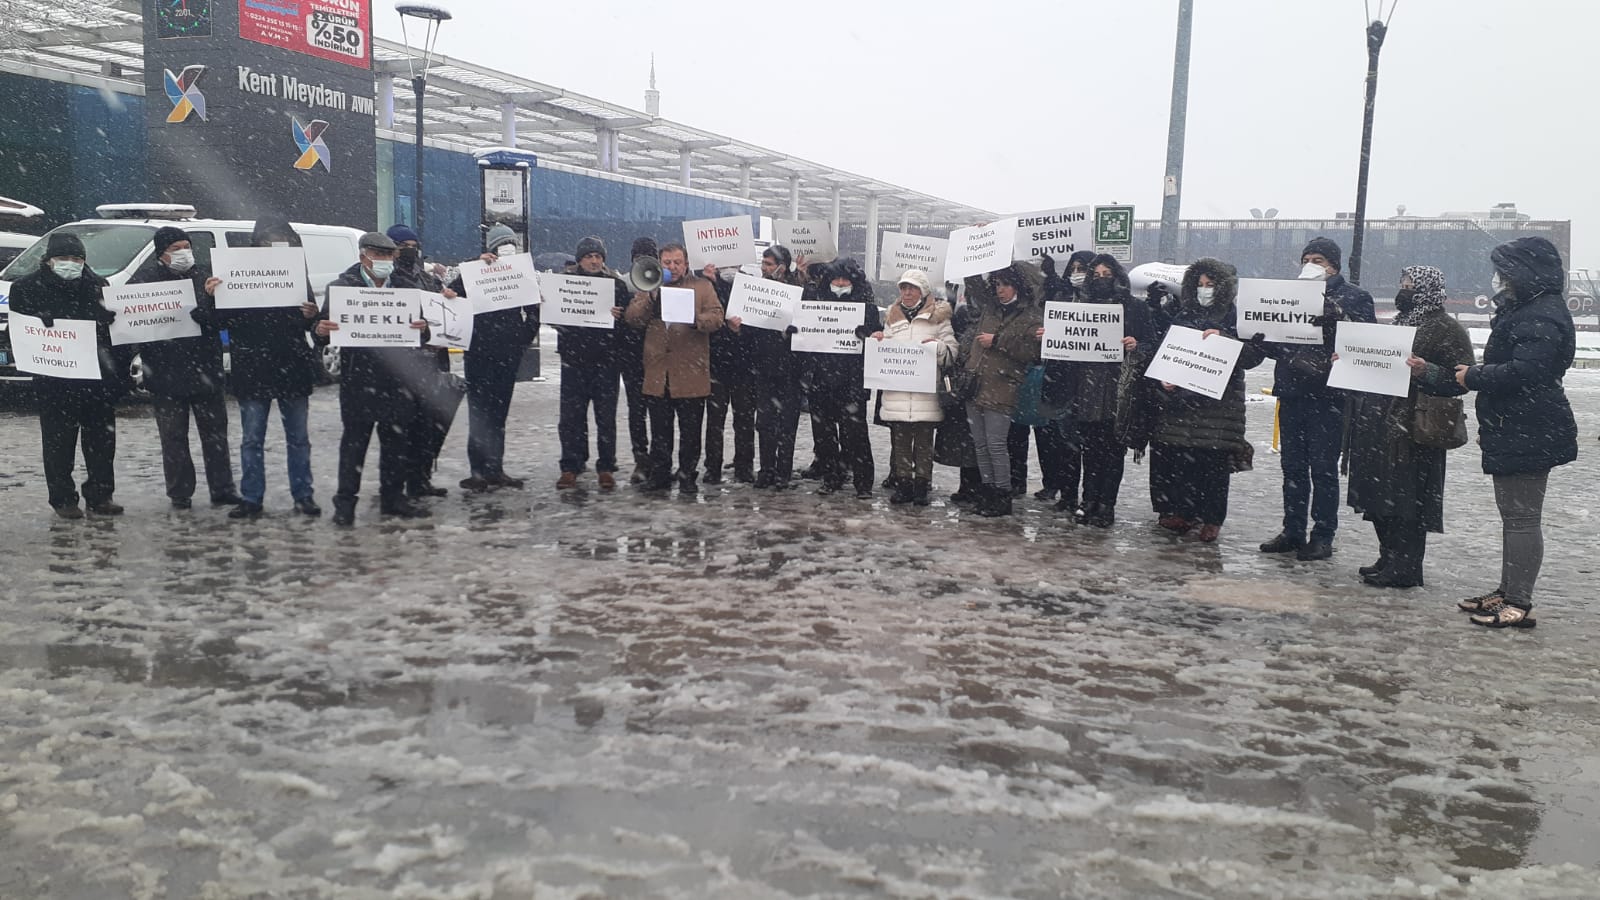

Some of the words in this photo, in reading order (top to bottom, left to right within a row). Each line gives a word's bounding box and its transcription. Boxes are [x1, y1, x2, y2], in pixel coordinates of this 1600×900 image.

[328, 14, 355, 26] ÜRÜN
[311, 19, 360, 47] %50
[314, 36, 358, 56] İNDİRİMLİ
[237, 65, 277, 96] Kent
[282, 75, 346, 110] Meydanı
[351, 95, 374, 116] AVM
[1018, 212, 1085, 228] EMEKLİNİN
[697, 226, 739, 240] İNTİBAK
[1032, 227, 1072, 241] SESİNİ
[702, 243, 738, 252] İSTİYORUZ!
[904, 242, 931, 251] BAYRAM
[1032, 244, 1074, 256] DUYUN
[896, 250, 938, 262] İKRAMİYELERİ
[964, 250, 996, 262] İSTİYORUZ!
[230, 270, 289, 278] FATURALARIMI
[227, 281, 294, 290] ÖDEYEMİYORUM
[744, 283, 769, 295] SADAKA
[116, 292, 150, 301] EMEKLİLER
[152, 289, 183, 298] ARASINDA
[124, 301, 182, 314] AYRIMCILIK
[362, 300, 379, 308] gün
[1048, 310, 1120, 323] EMEKLİLERİN
[1244, 311, 1316, 324] EMEKLİYİZ
[25, 326, 77, 340] SEYYANEN
[1065, 326, 1098, 337] HAYIR
[42, 344, 62, 353] ZAM
[878, 346, 924, 355] EMEKLİLERDEN
[1047, 339, 1090, 351] DUASINI
[1094, 342, 1119, 352] AL...
[1344, 346, 1402, 357] TORUNLARIMIZDAN
[32, 355, 77, 368] İSTİYORUZ!
[1173, 356, 1223, 376] Görüyorsun?
[1352, 359, 1392, 369] UTANIYORUZ!
